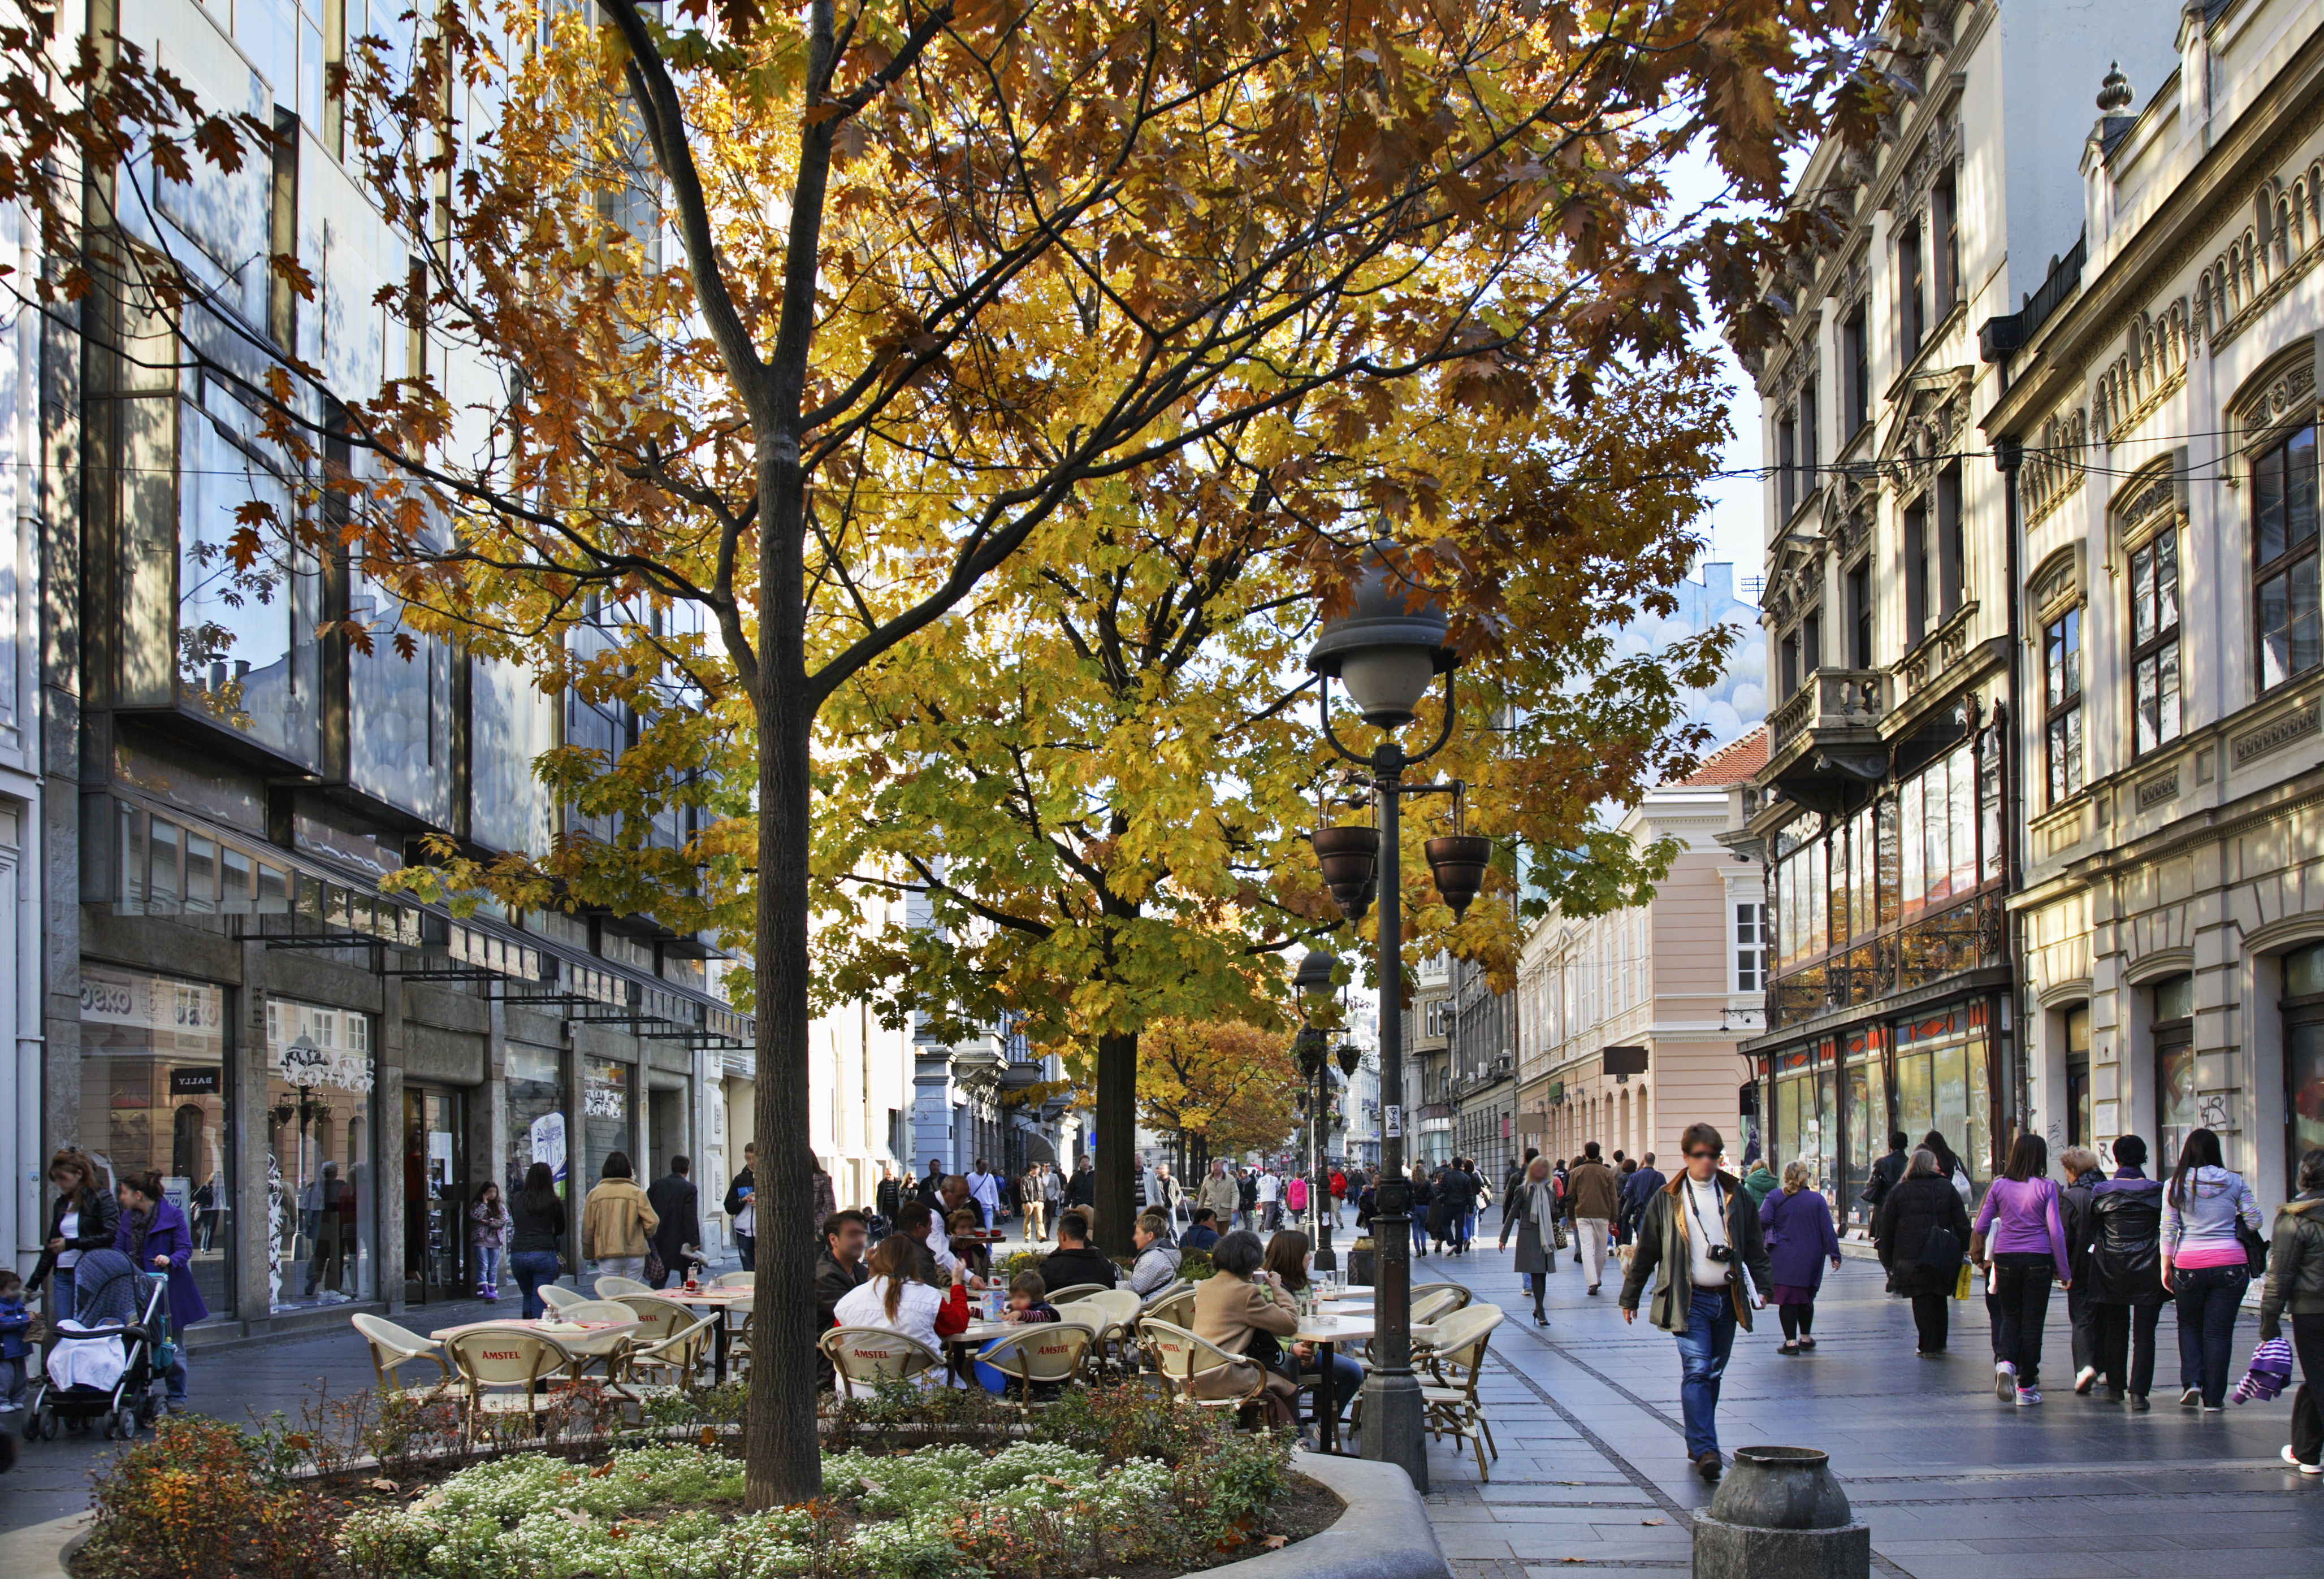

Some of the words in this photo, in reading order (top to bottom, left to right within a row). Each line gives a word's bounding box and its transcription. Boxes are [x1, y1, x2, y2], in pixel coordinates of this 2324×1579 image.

[482, 1350, 521, 1360] AMSTEL
[854, 1348, 890, 1359] AMSTEL
[1037, 1344, 1069, 1355] AMSTEL
